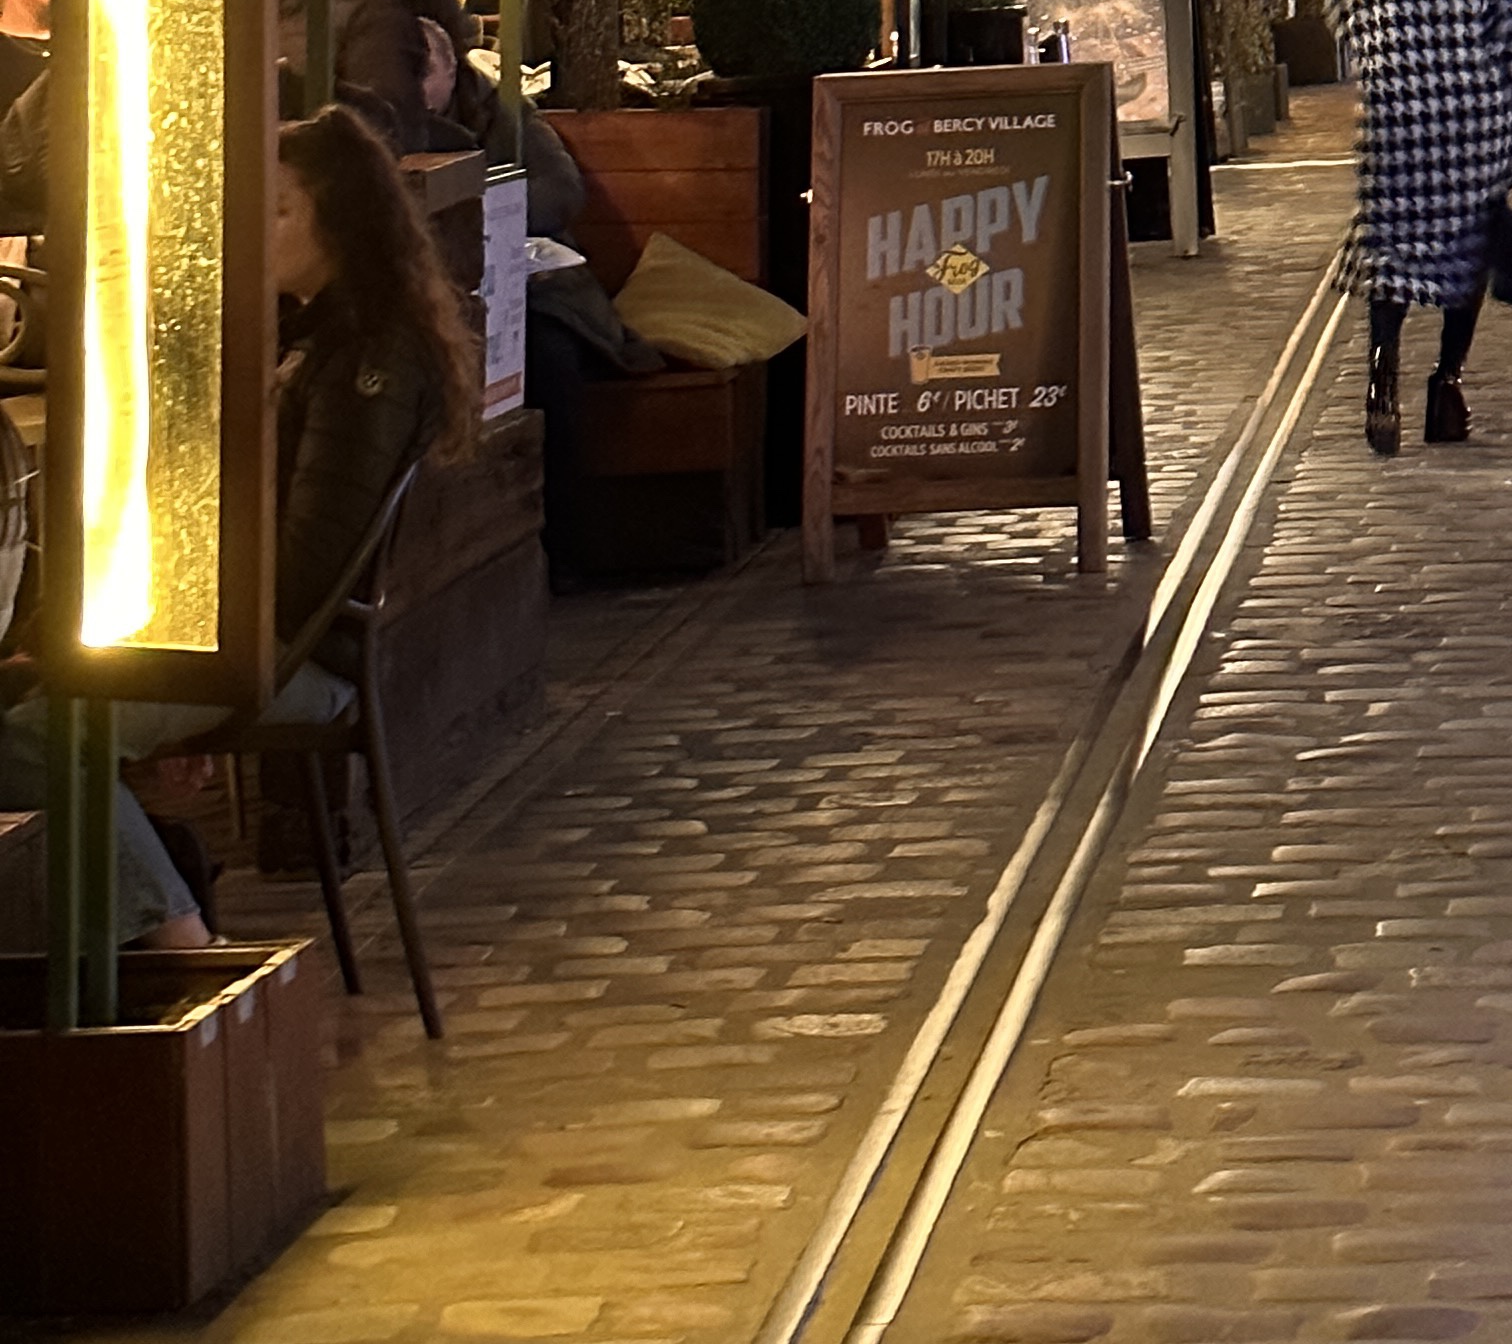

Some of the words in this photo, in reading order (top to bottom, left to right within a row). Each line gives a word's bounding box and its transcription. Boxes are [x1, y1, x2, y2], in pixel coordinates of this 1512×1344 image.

[863, 120, 914, 136] FROG
[933, 117, 986, 133] BERCY
[988, 114, 1056, 130] VILLAGE
[926, 150, 950, 167] 17H
[965, 148, 995, 165] 20H
[866, 175, 1049, 281] HAPPY
[889, 267, 1024, 358] HOUR
[845, 392, 899, 415] PINTE
[955, 387, 1020, 411] PICHET
[881, 424, 945, 440] COCKTAILS
[960, 422, 988, 436] GINS
[870, 443, 927, 458] COCKTAILS
[929, 442, 956, 454] SANS
[958, 441, 998, 454] ALCOOL
